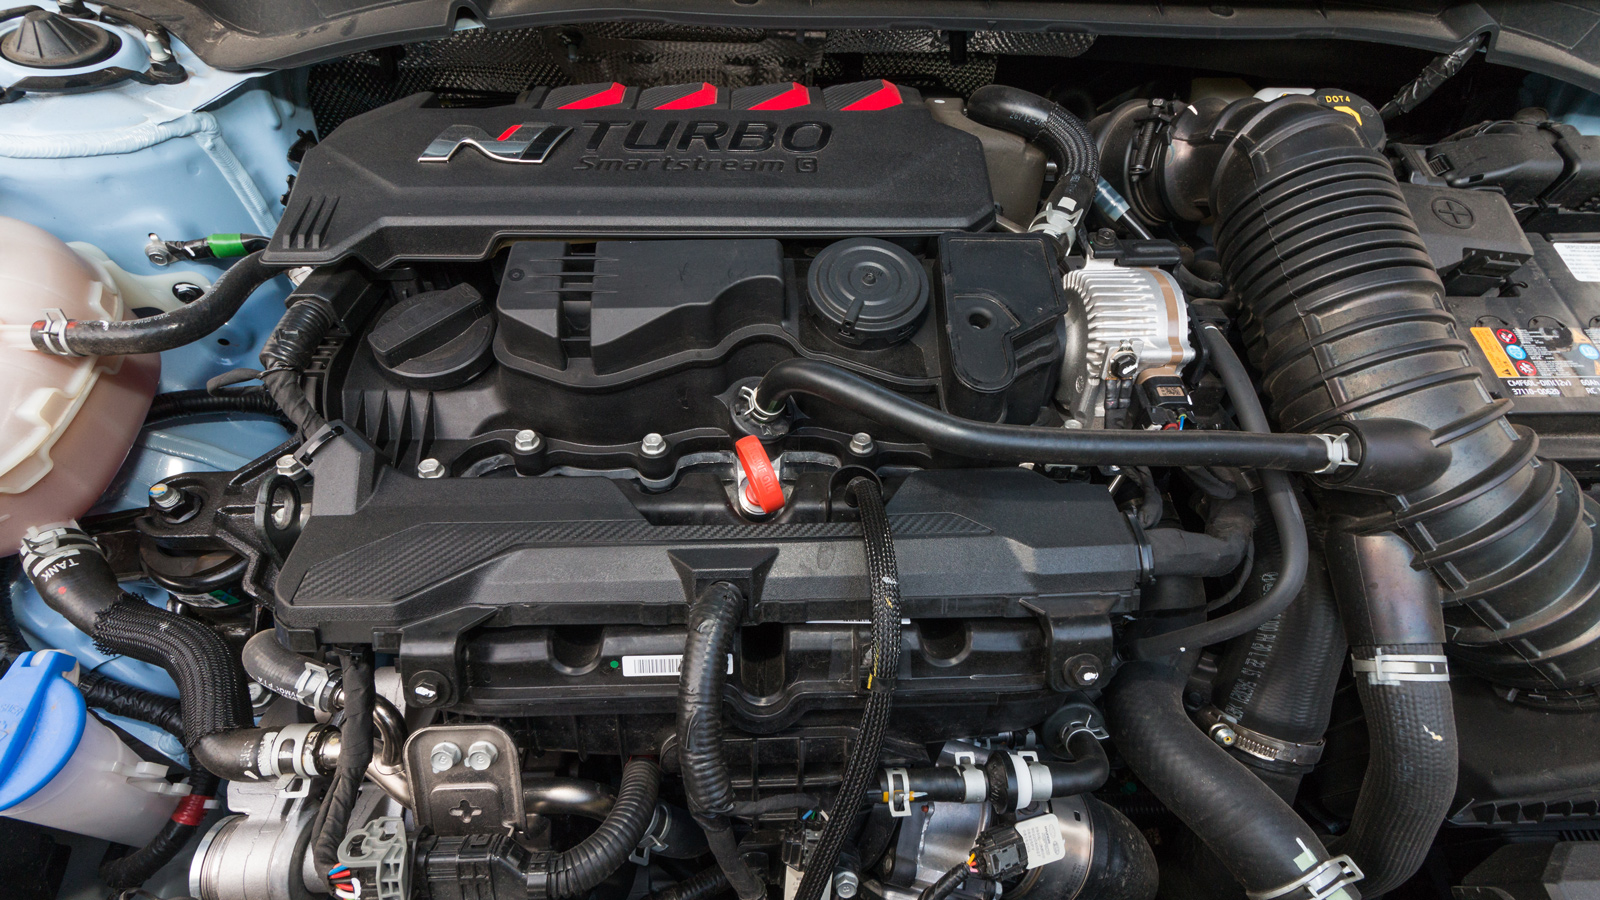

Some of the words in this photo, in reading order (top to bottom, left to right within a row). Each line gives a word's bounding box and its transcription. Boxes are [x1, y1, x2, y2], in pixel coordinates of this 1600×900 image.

[582, 119, 833, 153] TURBO
[573, 154, 785, 172] Smartstream
[796, 156, 818, 173] G
[761, 475, 776, 494] OIL
[41, 558, 80, 582] TANK
